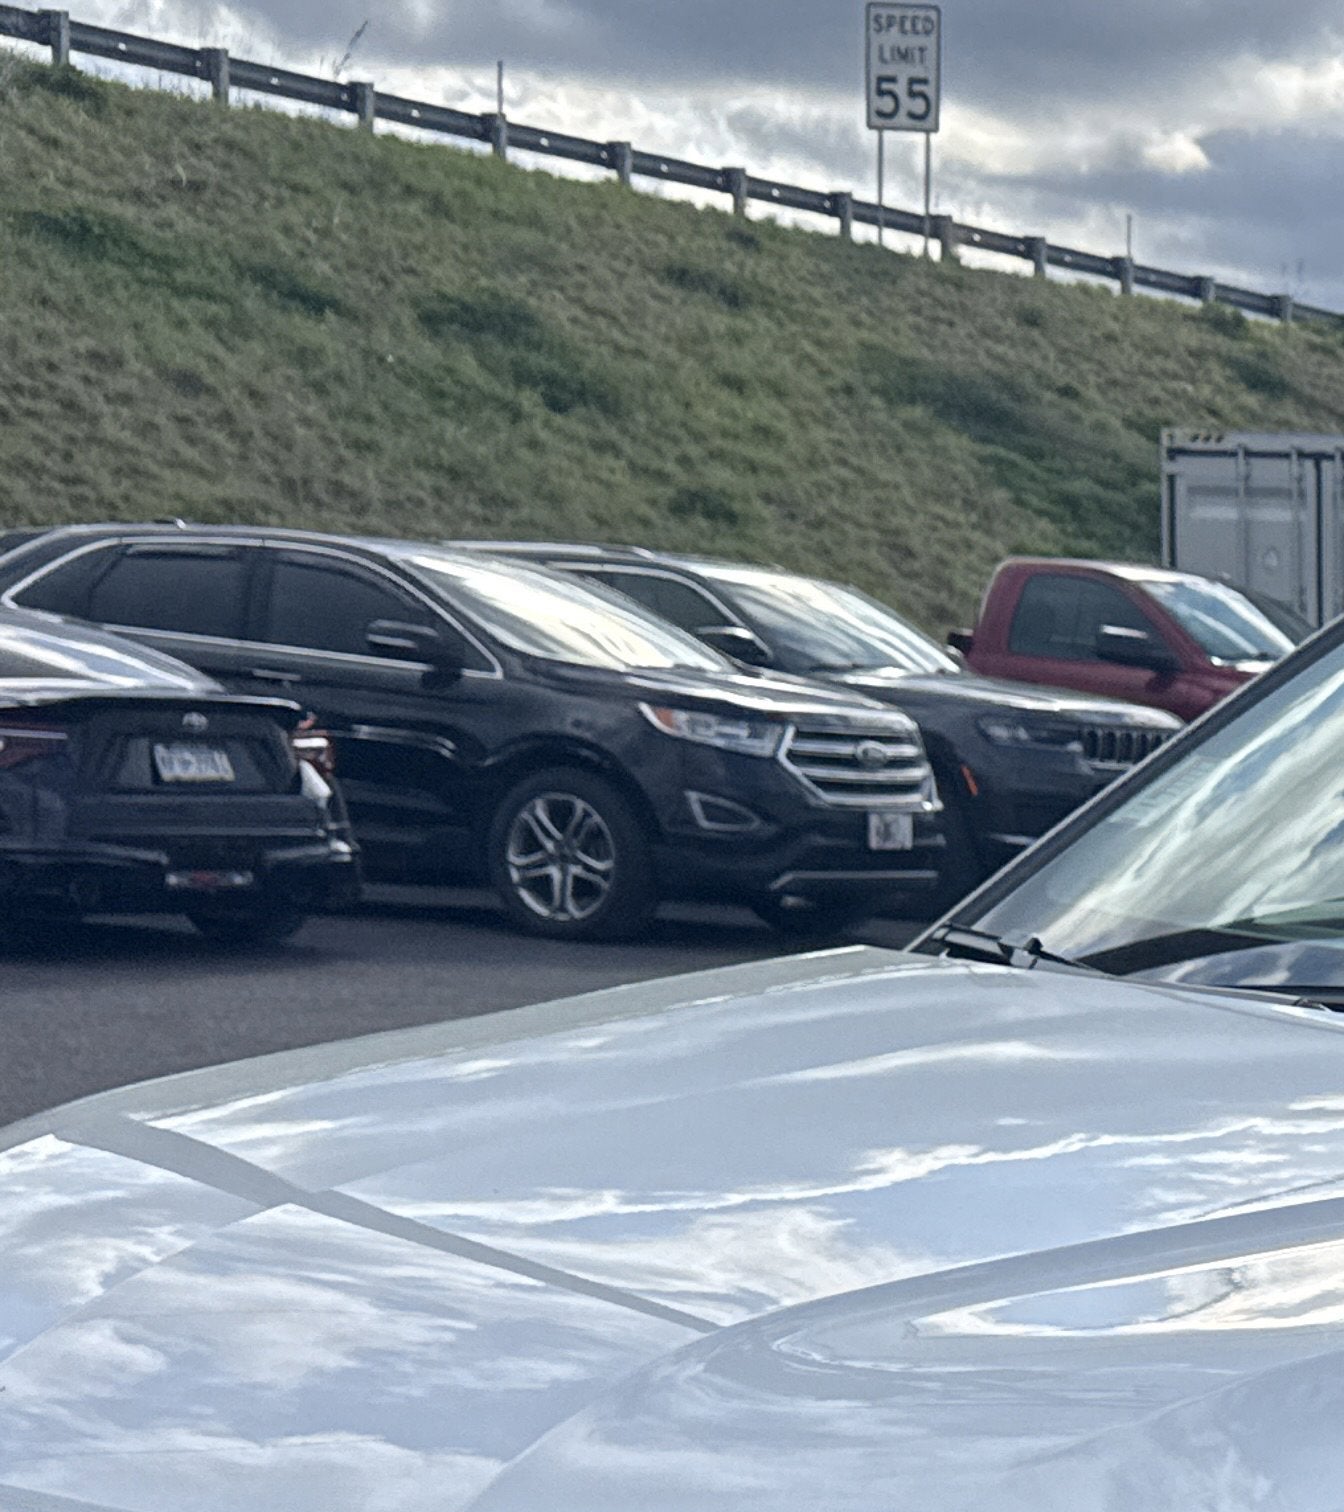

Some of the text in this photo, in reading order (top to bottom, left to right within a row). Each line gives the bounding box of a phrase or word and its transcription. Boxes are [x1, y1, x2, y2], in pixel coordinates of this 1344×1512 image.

[873, 14, 934, 36] SPEED
[878, 44, 928, 65] LIMIT
[875, 75, 931, 120] 55
